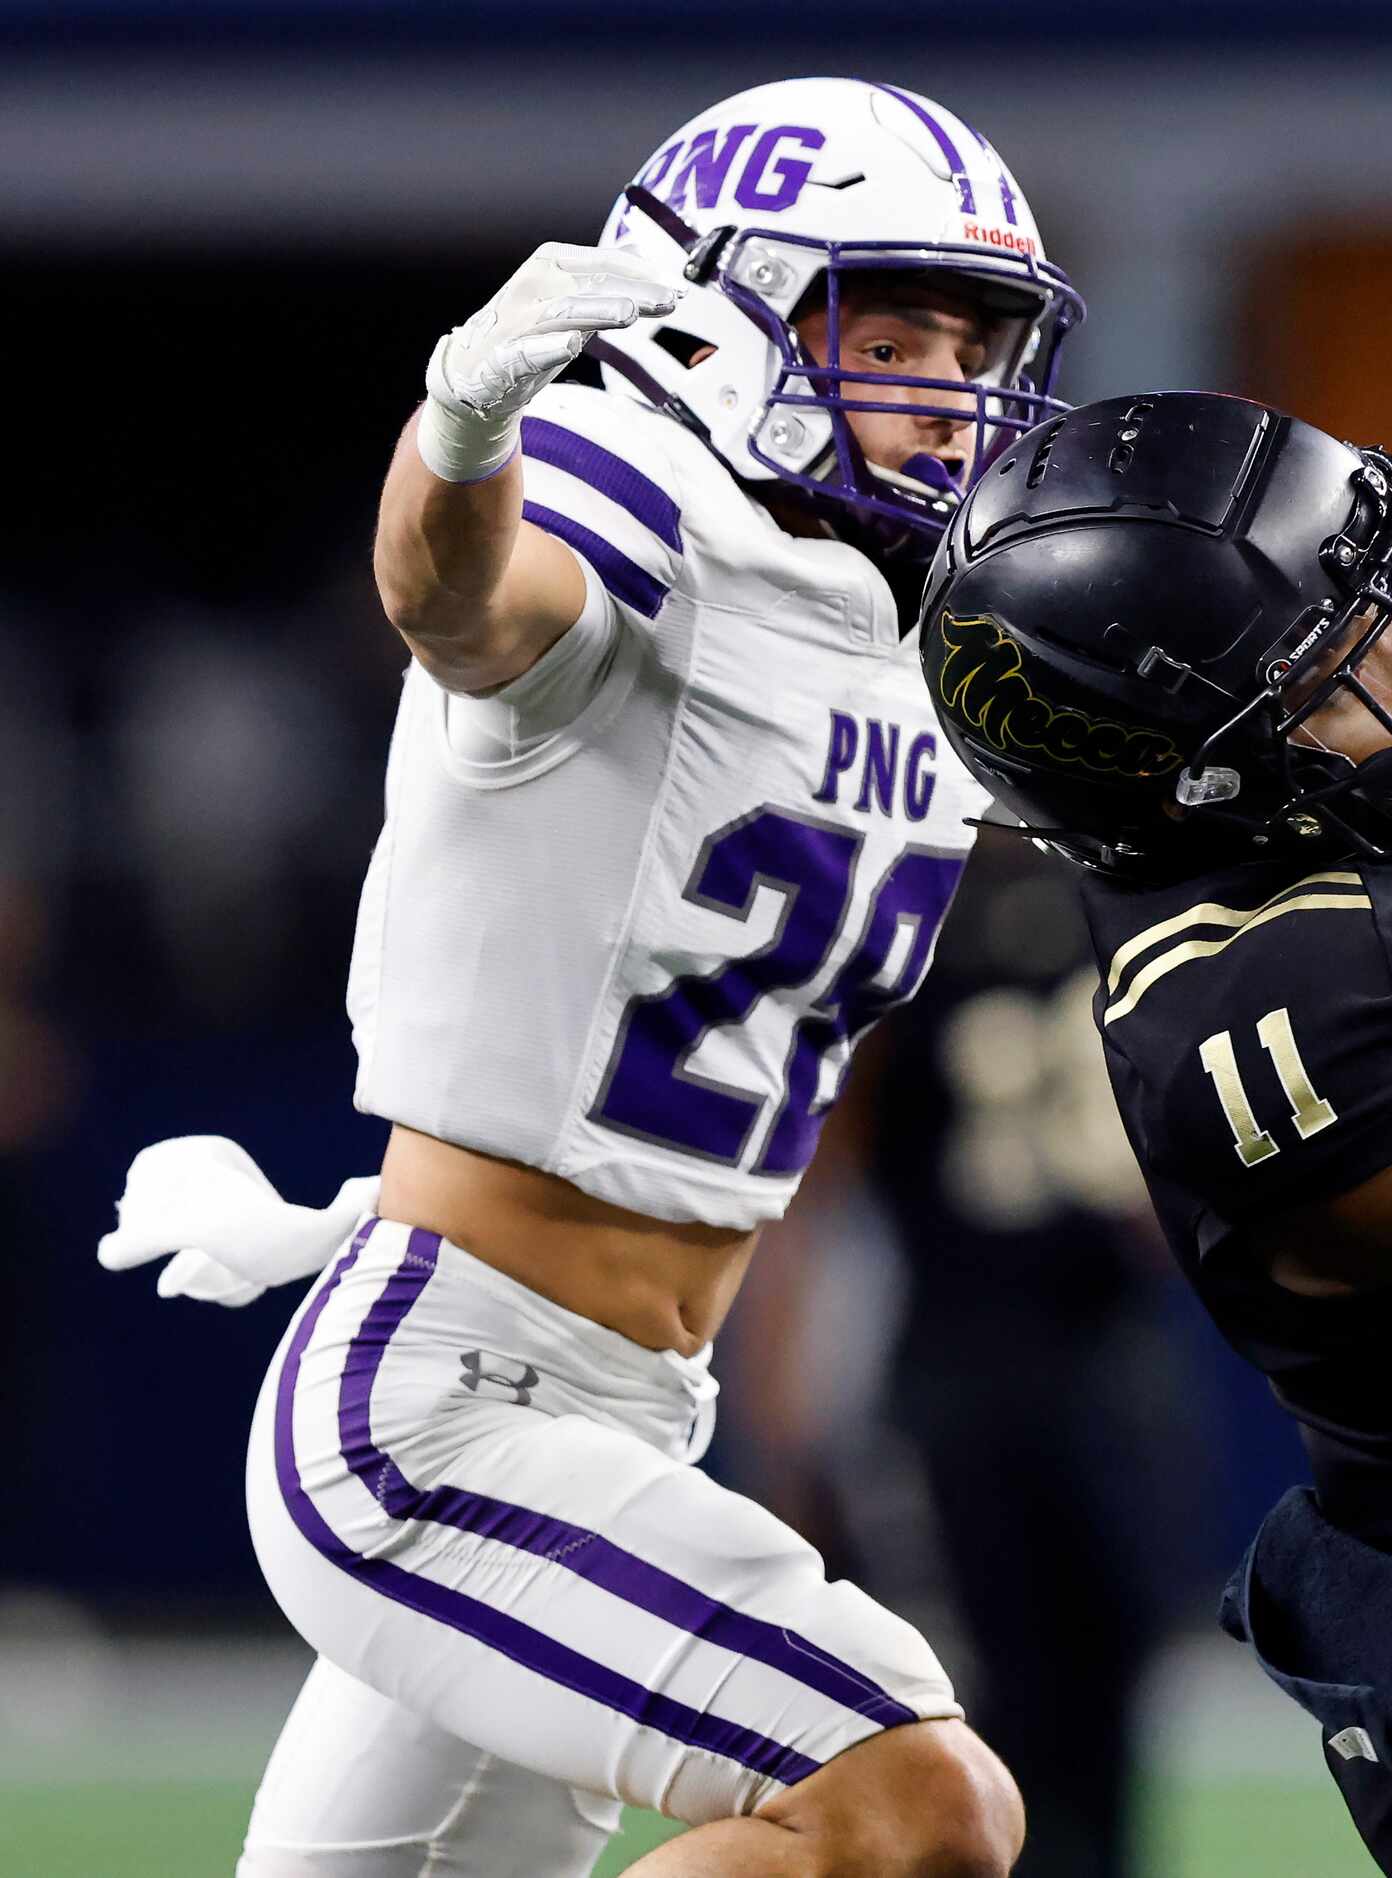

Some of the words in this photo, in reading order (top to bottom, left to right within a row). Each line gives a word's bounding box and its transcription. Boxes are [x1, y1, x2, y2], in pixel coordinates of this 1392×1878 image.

[964, 220, 1037, 256] Riddell
[1288, 616, 1331, 666] SPORTS
[811, 707, 938, 823] PNG
[1199, 1007, 1338, 1168] 11
